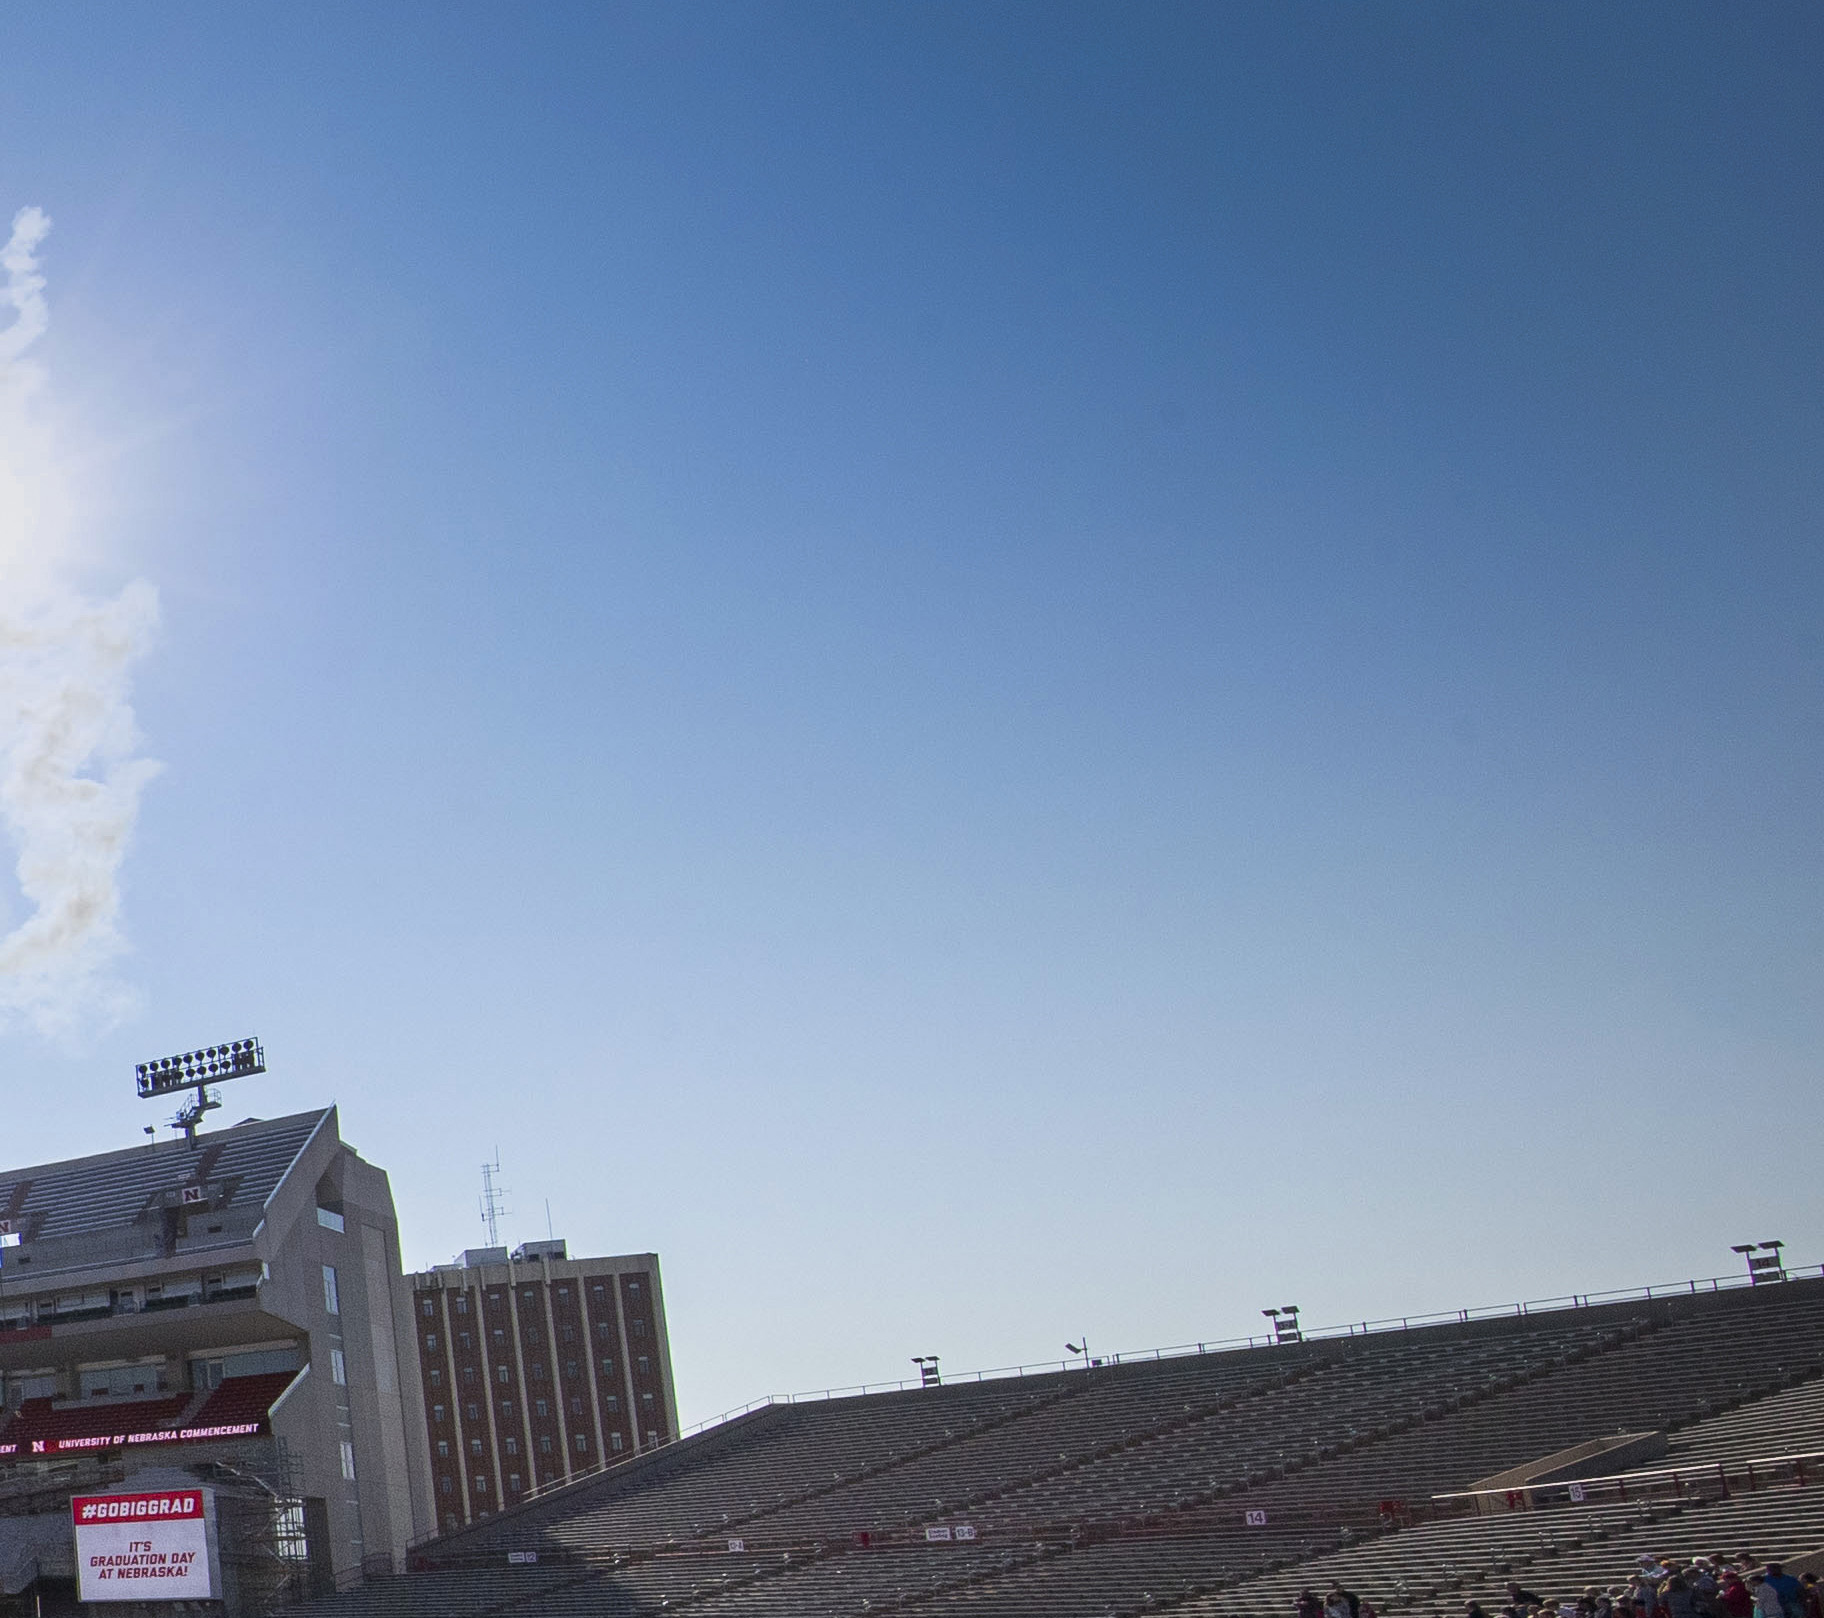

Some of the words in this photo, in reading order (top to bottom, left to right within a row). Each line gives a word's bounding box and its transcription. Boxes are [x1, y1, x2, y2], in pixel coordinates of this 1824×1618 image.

[185, 1189, 199, 1201] N
[32, 1441, 44, 1453] N
[58, 1437, 111, 1448] UNIVERSITY
[113, 1435, 125, 1444] OF
[127, 1430, 177, 1443] NEBRASKA
[180, 1423, 259, 1438] COMMENCEMENT
[82, 1498, 195, 1519] #GOBIGGRAD
[1248, 1512, 1264, 1524] 14
[129, 1541, 152, 1553] IT'S
[90, 1553, 166, 1567] GRADUATION
[171, 1552, 196, 1564] DAY
[98, 1568, 114, 1580] AT
[117, 1566, 188, 1579] NEBRASKA!
